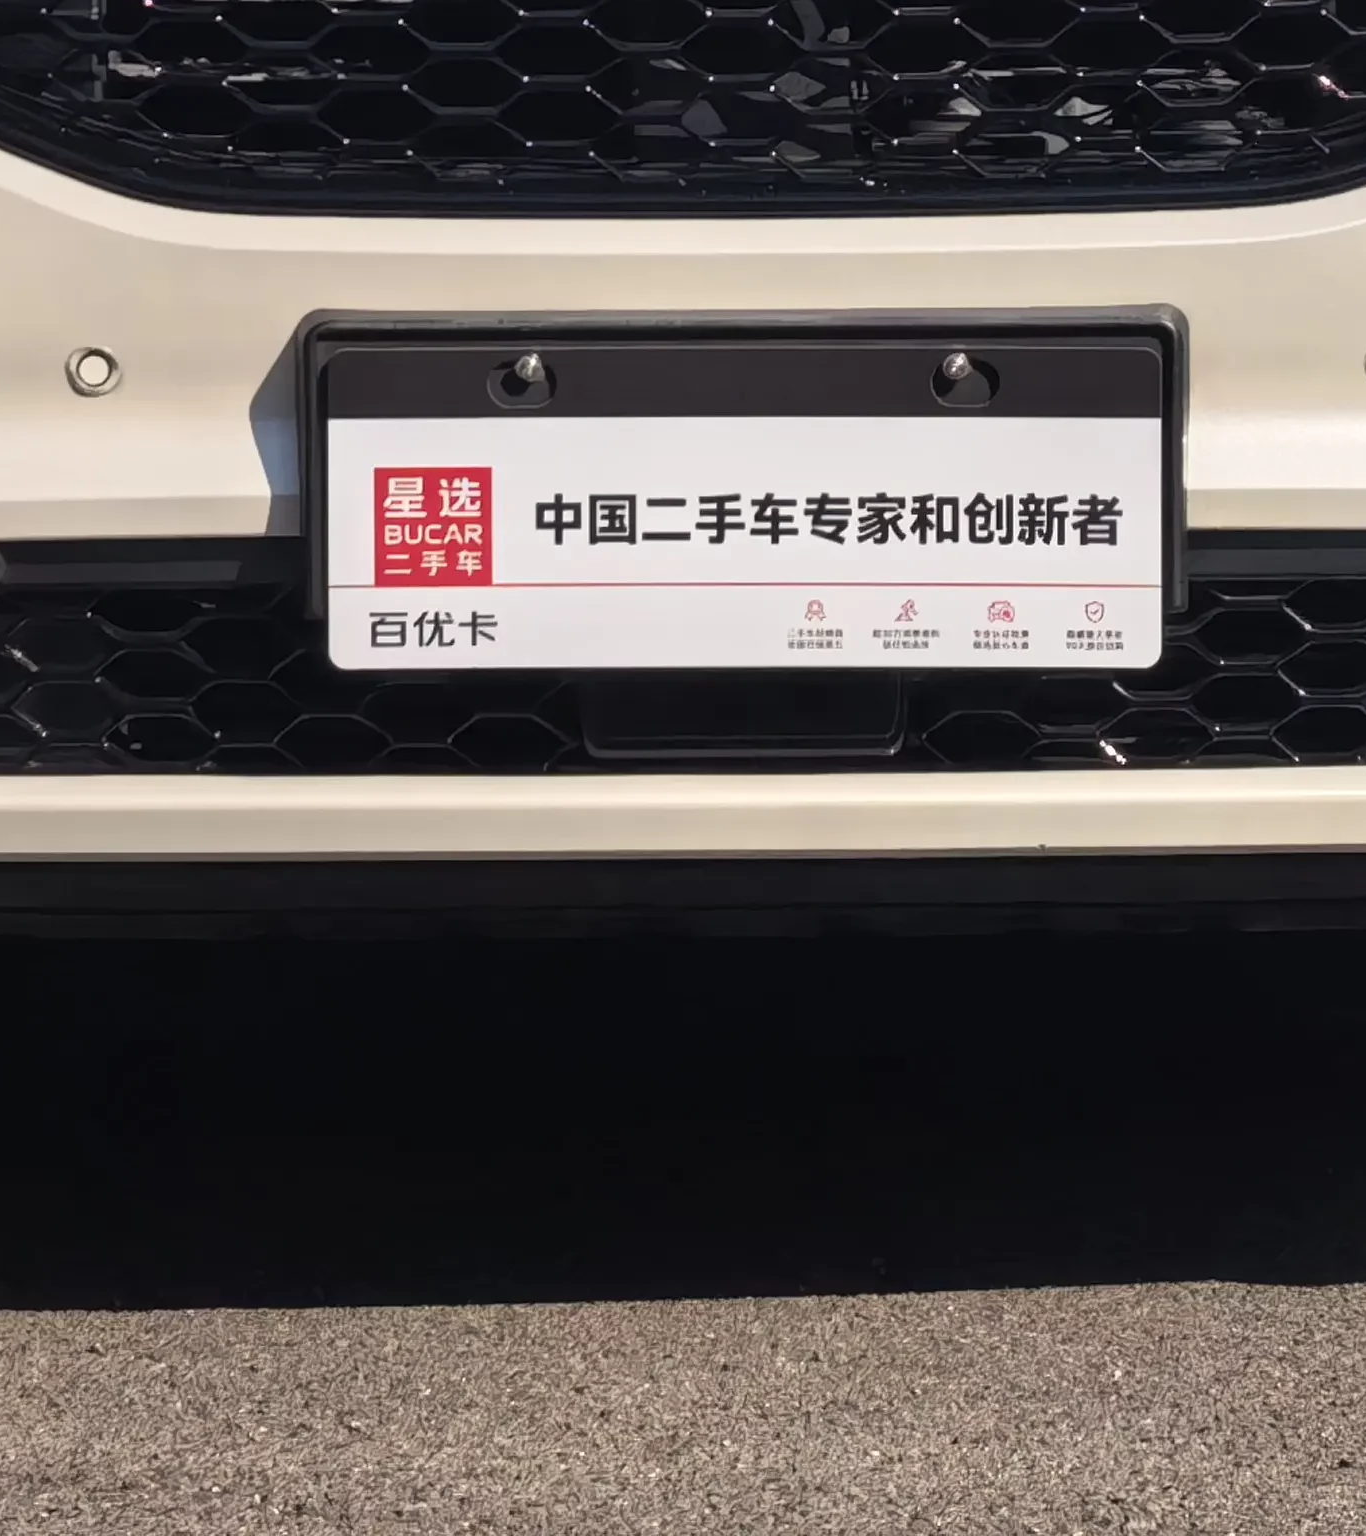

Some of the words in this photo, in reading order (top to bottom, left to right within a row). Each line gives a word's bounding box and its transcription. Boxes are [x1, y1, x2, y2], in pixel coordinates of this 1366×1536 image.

[383, 476, 482, 518] 星选
[384, 523, 483, 545] BUCAR
[534, 493, 1124, 546] 中国二手车专家和创新者
[383, 550, 482, 576] 二手车
[369, 611, 498, 647] 百优卡
